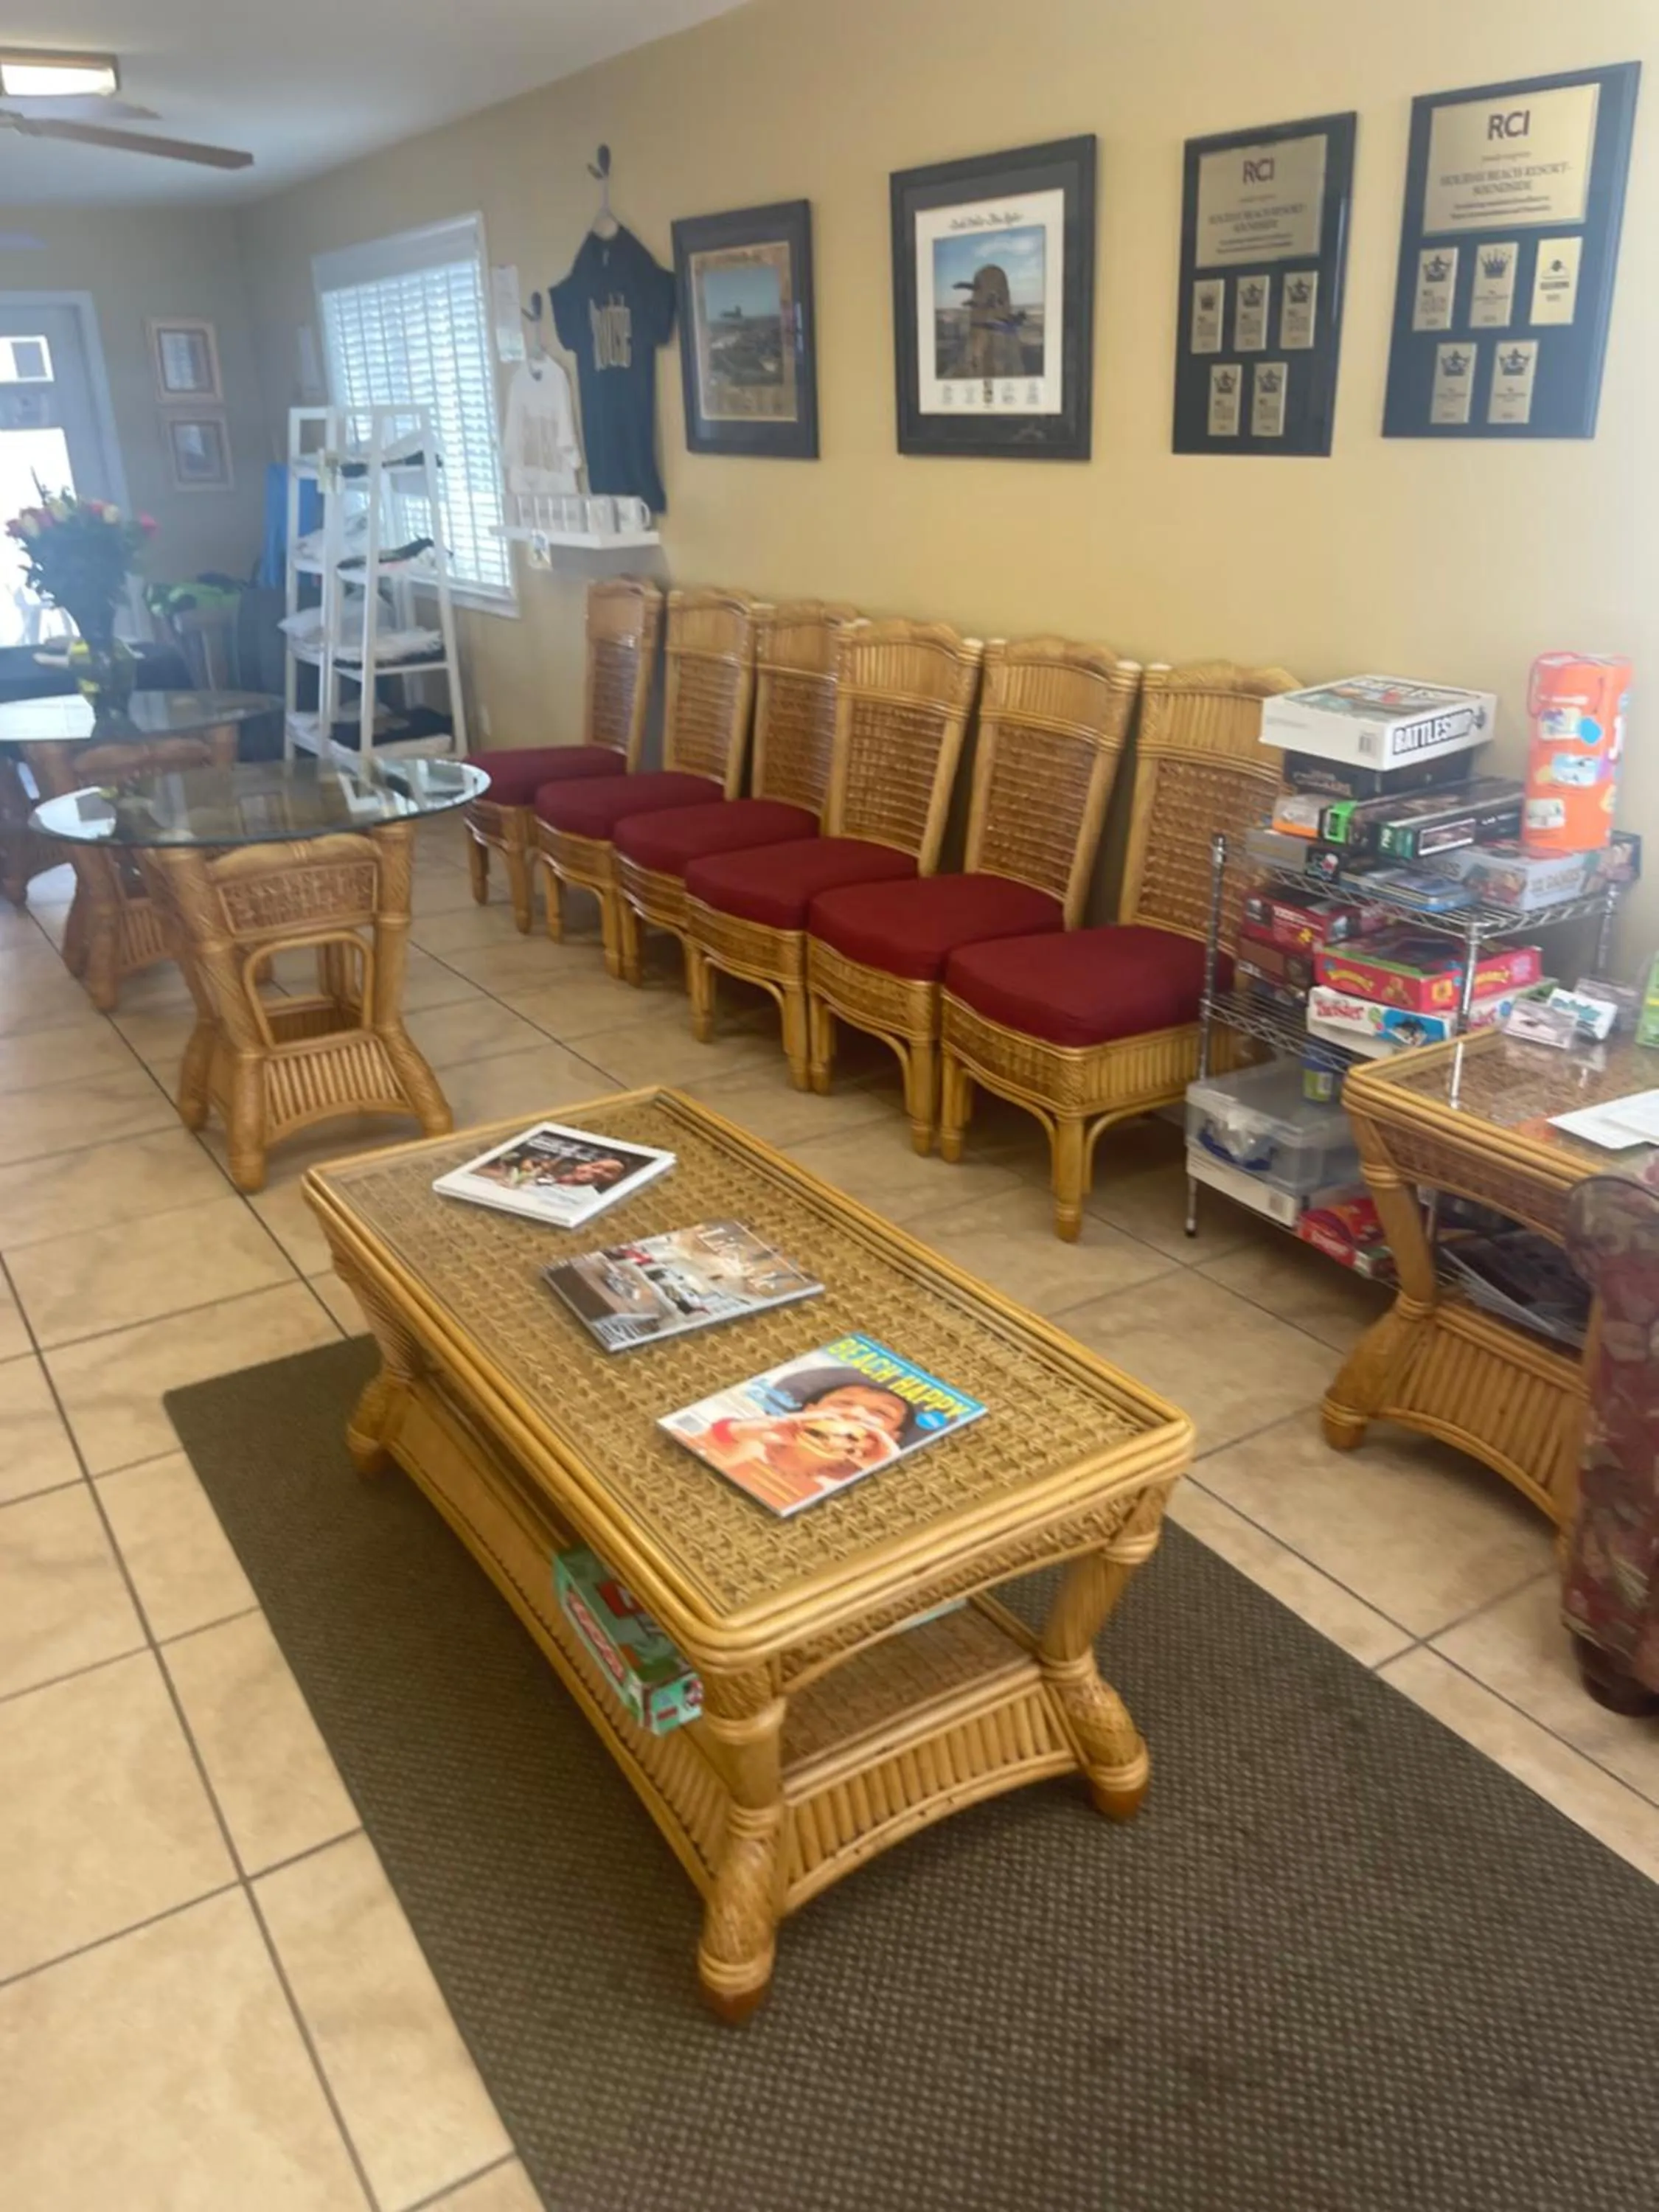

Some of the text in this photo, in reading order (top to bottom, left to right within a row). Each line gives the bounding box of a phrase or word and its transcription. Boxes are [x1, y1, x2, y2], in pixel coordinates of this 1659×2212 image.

[1487, 110, 1531, 141] RCI
[1242, 157, 1275, 184] RCI
[1394, 710, 1473, 754] BATTLES
[828, 1338, 970, 1419] BEACH HAPPY
